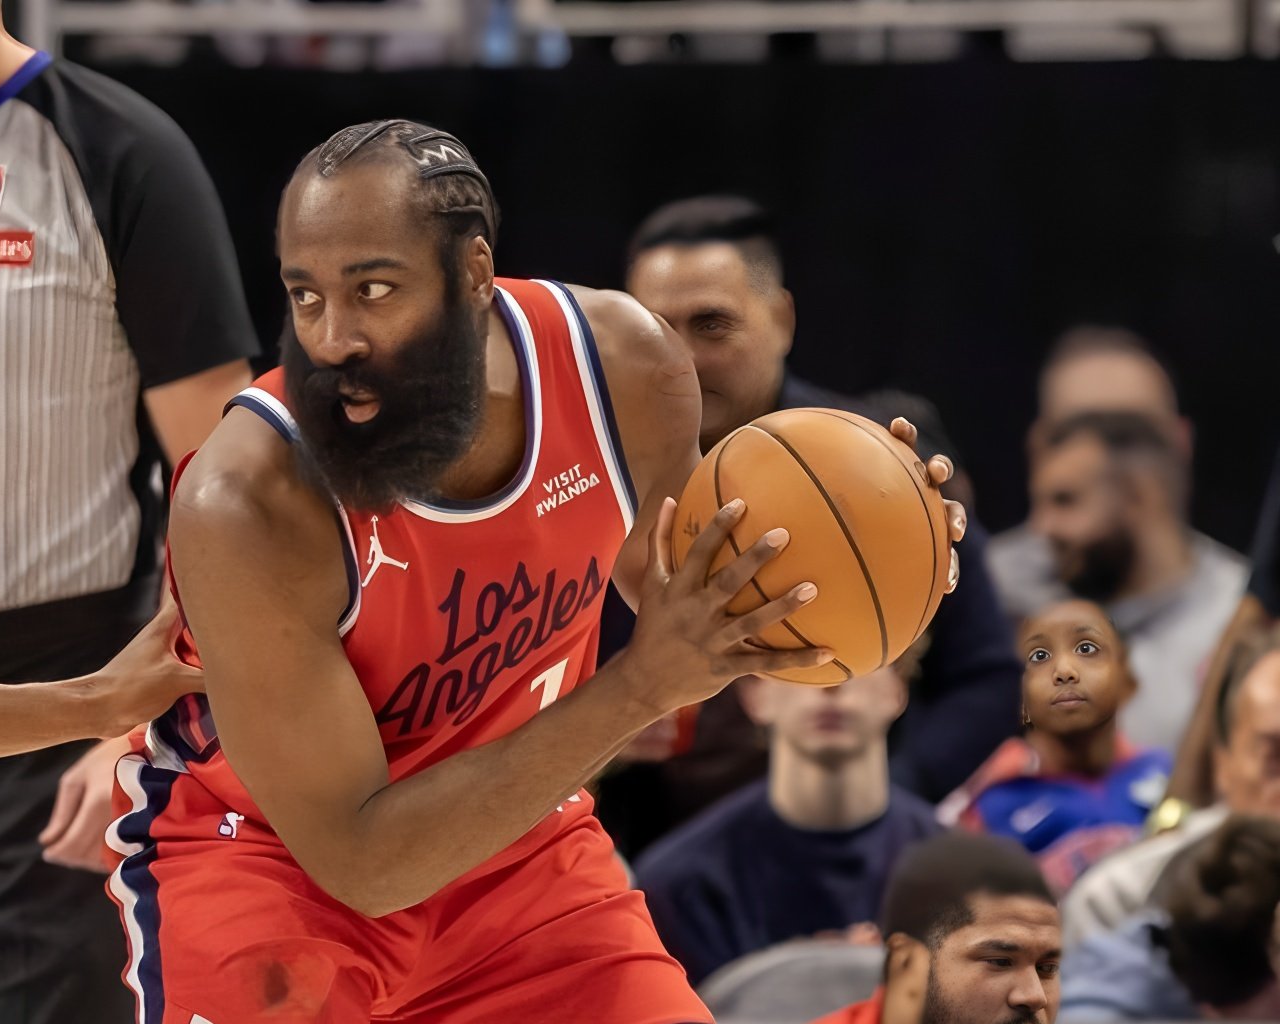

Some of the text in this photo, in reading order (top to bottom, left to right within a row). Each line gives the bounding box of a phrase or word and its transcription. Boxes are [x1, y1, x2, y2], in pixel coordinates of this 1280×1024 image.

[535, 472, 601, 518] RWANDA
[542, 463, 581, 494] VISIT
[375, 555, 606, 737] Angeles
[435, 560, 541, 666] Los
